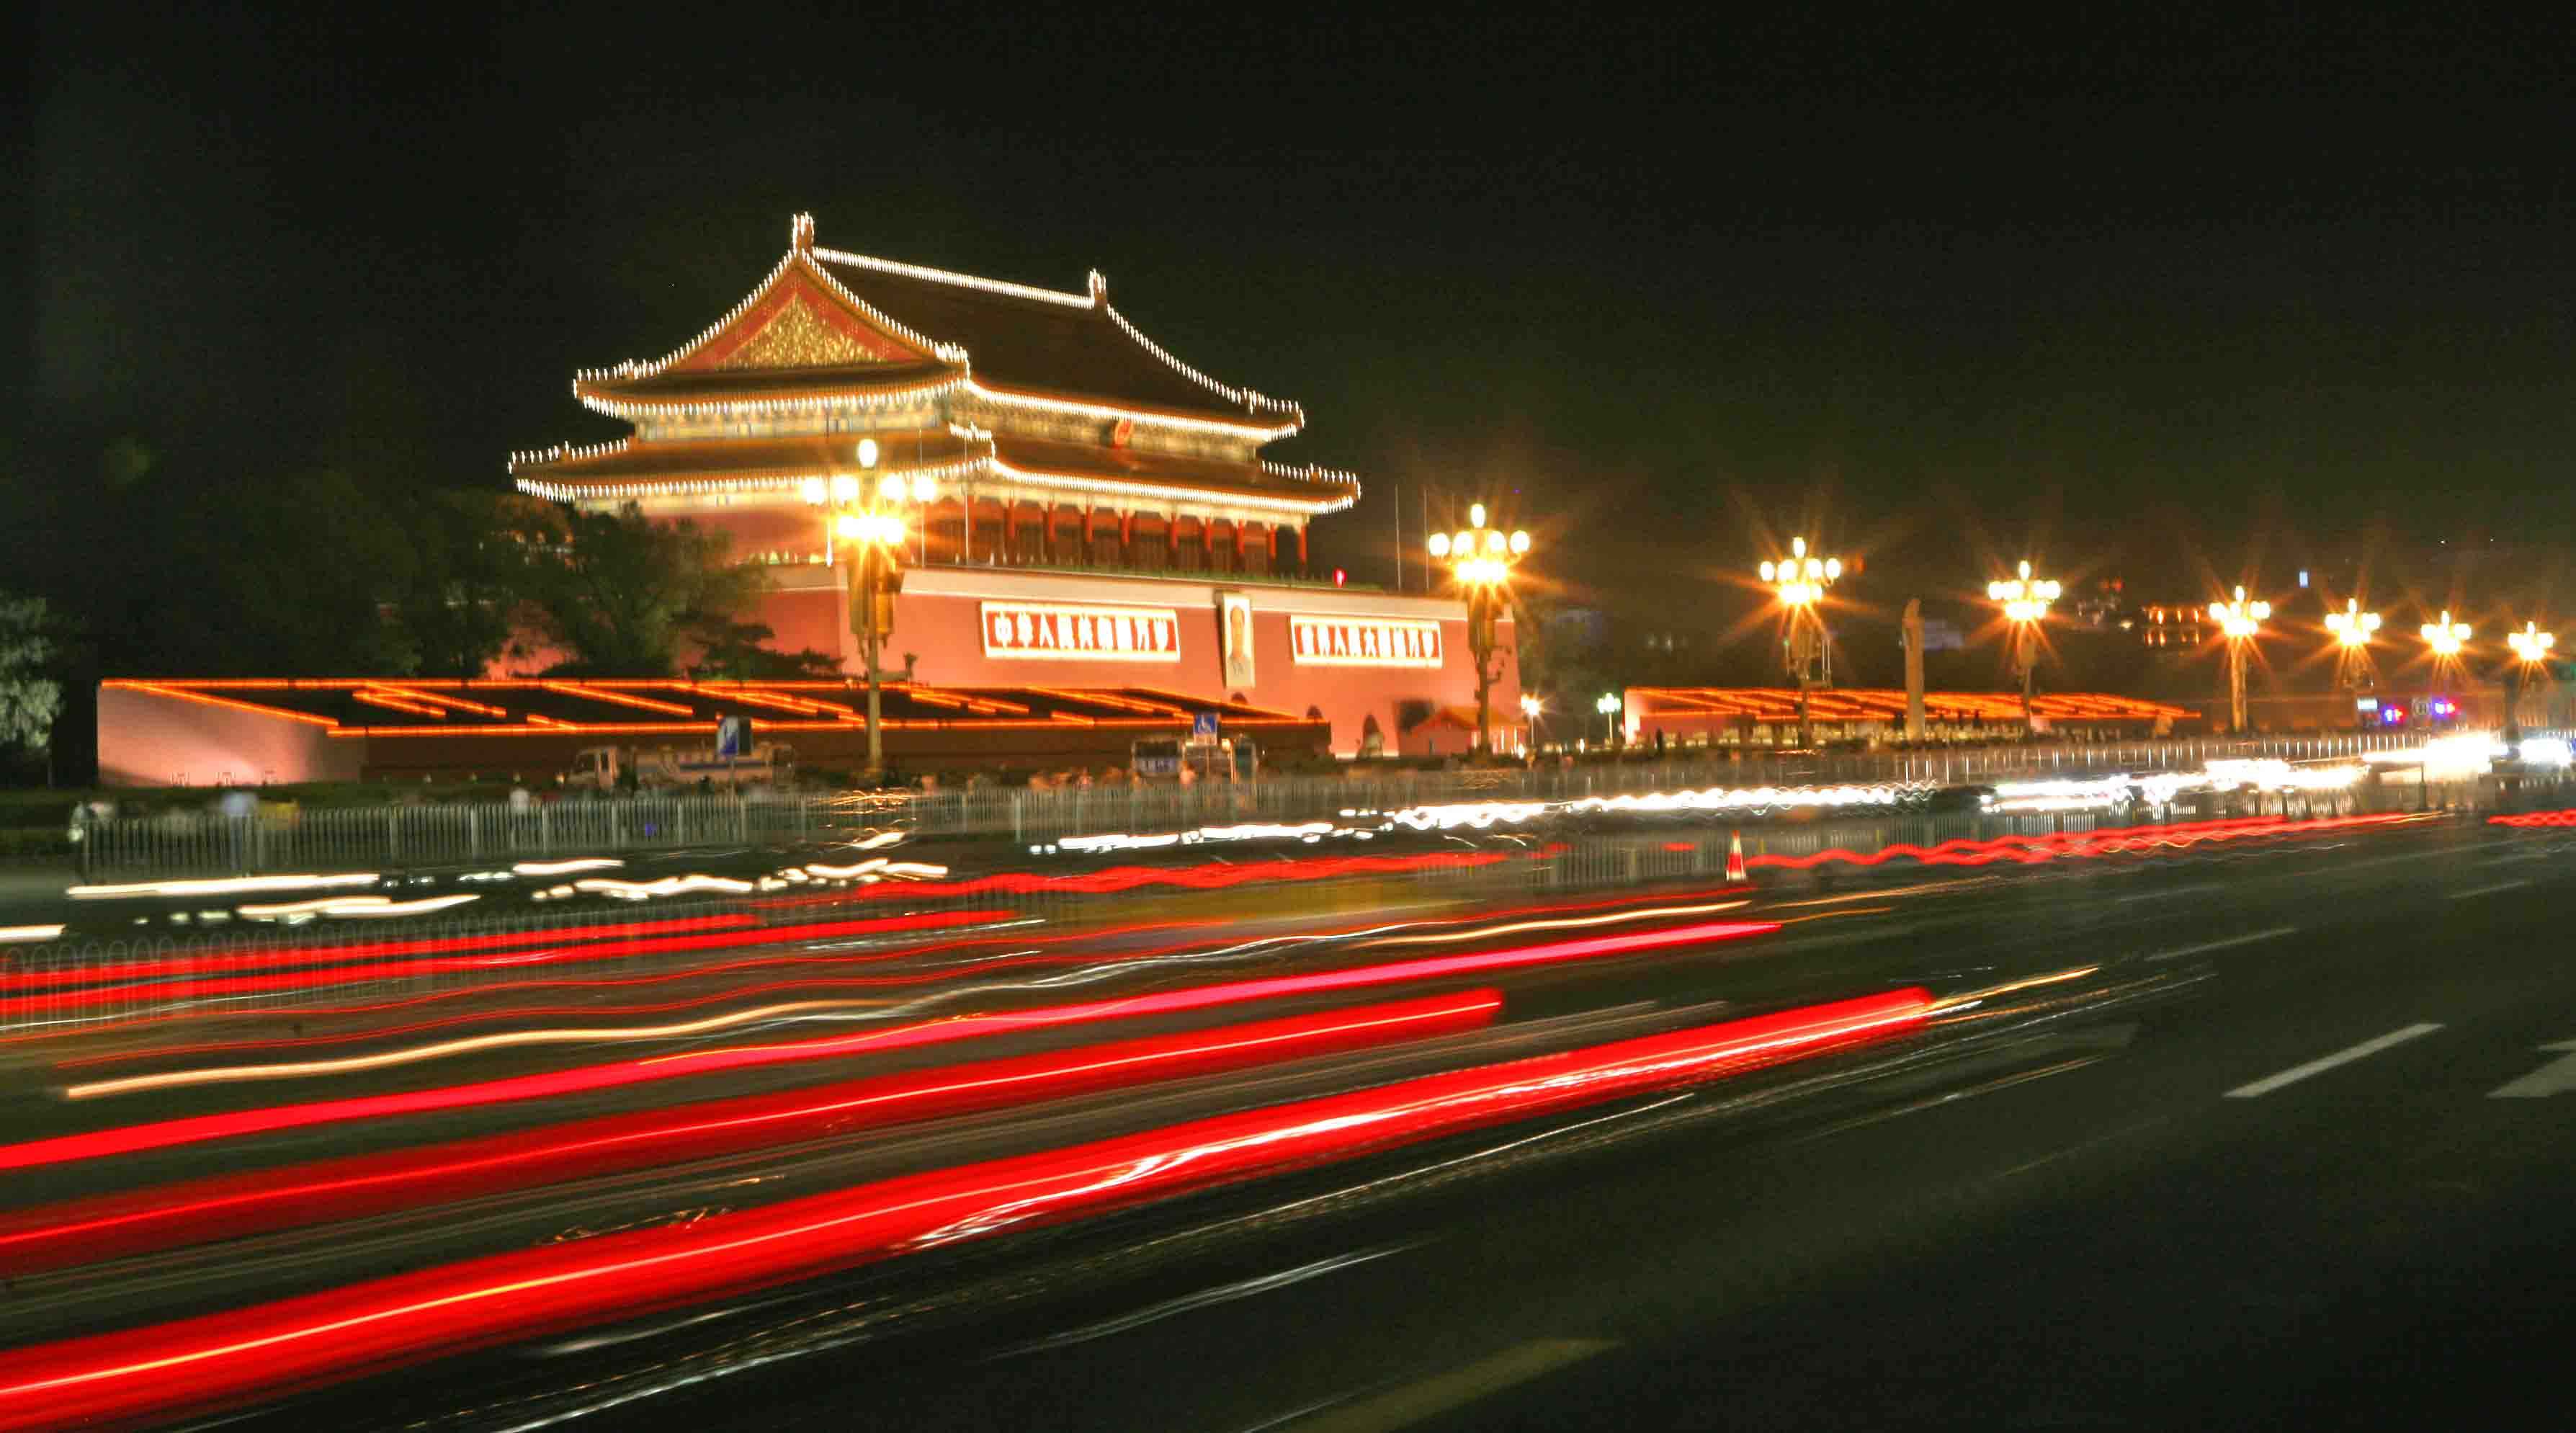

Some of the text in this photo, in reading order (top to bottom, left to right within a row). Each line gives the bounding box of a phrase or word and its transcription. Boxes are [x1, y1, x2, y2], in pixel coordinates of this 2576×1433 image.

[994, 611, 1168, 651] 中华人共万岁
[1300, 622, 1434, 659] 界人大万岁
